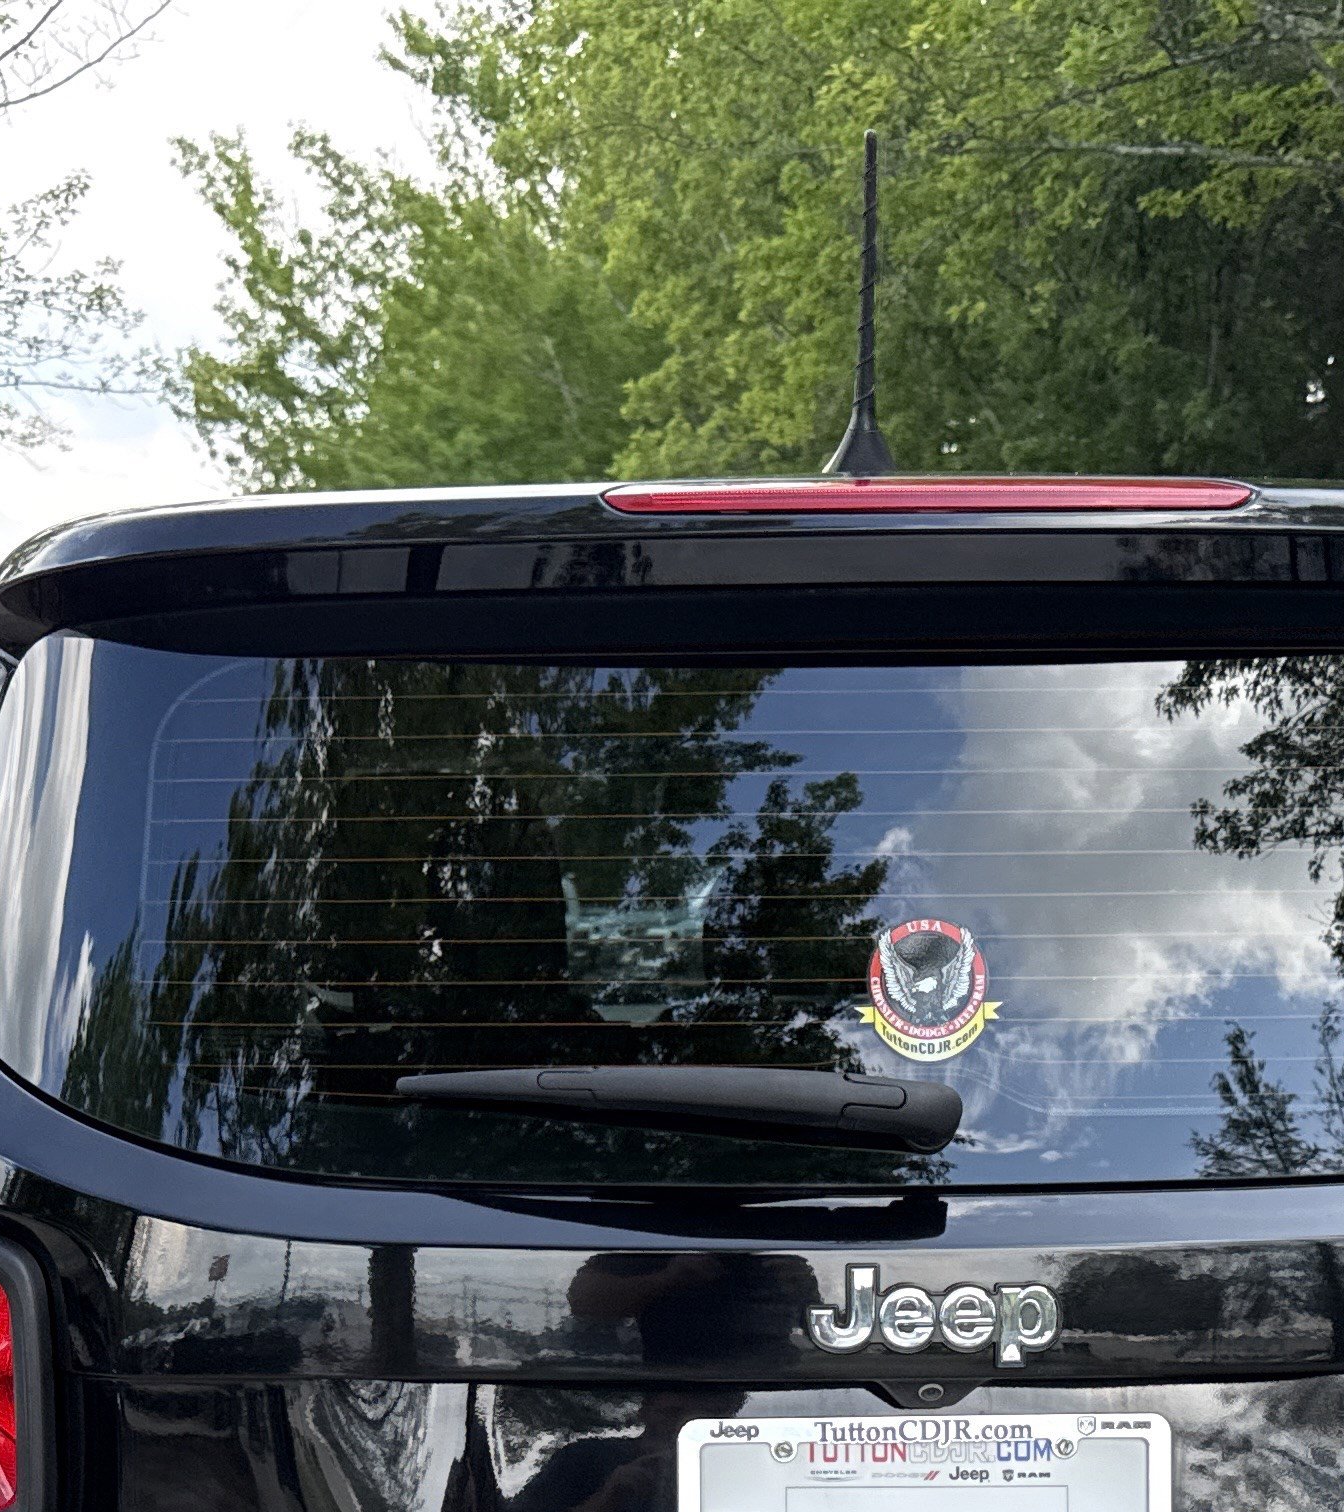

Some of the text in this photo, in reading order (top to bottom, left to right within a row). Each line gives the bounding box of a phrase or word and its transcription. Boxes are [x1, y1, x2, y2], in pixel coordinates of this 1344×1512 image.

[905, 919, 942, 933] USA
[908, 1026, 949, 1037] DODGE
[954, 1003, 975, 1029] JEEP
[972, 974, 985, 1000] RAM
[880, 1022, 978, 1055] TuttonCDJR.com
[808, 1263, 1061, 1368] Jeep
[709, 1420, 760, 1441] Jeep
[814, 1419, 1034, 1445] TuttonCDJR.com
[1100, 1420, 1152, 1430] RAM
[949, 1466, 990, 1483] Jeep
[1017, 1471, 1051, 1479] RAM
